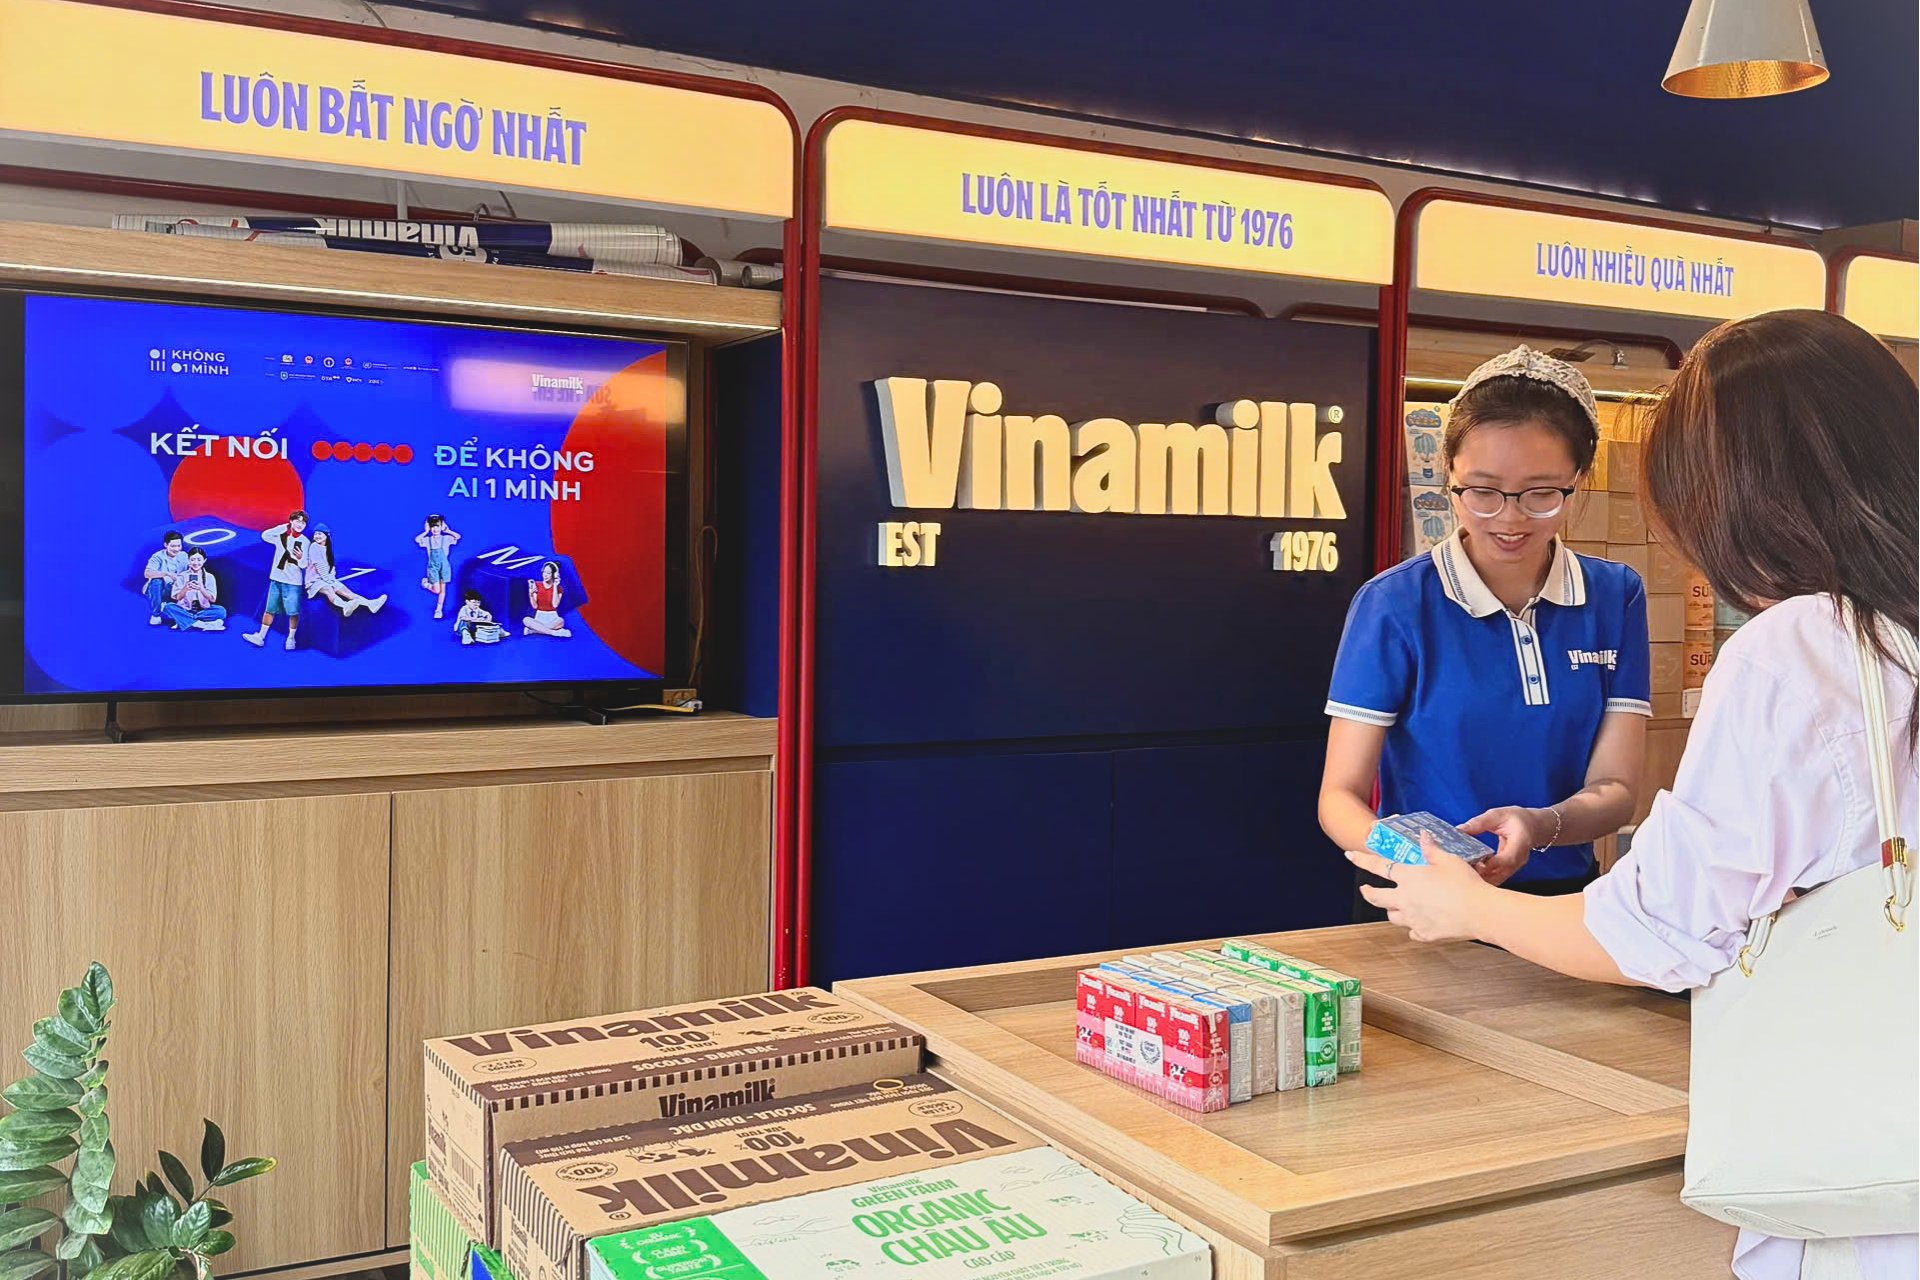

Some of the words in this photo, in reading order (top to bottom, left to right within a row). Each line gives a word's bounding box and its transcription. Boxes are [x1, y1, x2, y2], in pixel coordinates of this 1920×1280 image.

[201, 72, 308, 131] LUÔN
[319, 79, 394, 141] BẤT
[403, 97, 483, 152] NGỜ
[491, 106, 588, 166] NHẤT
[962, 172, 1033, 220] LUÔN
[1040, 179, 1072, 224] LÀ
[1078, 181, 1127, 230] TỐT
[1132, 190, 1197, 238] NHẤT
[1202, 200, 1236, 243] TỪ
[1241, 208, 1293, 249] 1976
[1536, 241, 1587, 280] LUÔN
[1592, 245, 1645, 287] NHIỀU
[1690, 257, 1734, 297] NHẤT
[172, 349, 225, 363] KHÔNG
[192, 362, 229, 375] MÌNH
[531, 373, 583, 390] Vinamilk
[151, 424, 219, 457] KẾT
[228, 426, 288, 459] NỐI
[434, 436, 478, 468] ĐỂ
[486, 443, 594, 473] KHÔNG
[884, 376, 1347, 519] Vinamilk
[449, 477, 478, 498] AI
[486, 478, 496, 498] 1
[505, 474, 582, 501] MÌNH
[881, 520, 941, 567] EST
[1274, 530, 1338, 572] 1976
[1567, 650, 1617, 665] Vinailk
[445, 993, 840, 1057] Vinamilk
[632, 1057, 697, 1072] SOCOLA
[659, 1079, 775, 1118] Vinamilk
[754, 1103, 816, 1120] SOCOLA
[575, 1119, 1019, 1217] Vinamilk
[868, 1177, 920, 1193] Vinamilk
[851, 1189, 908, 1208] GREEN
[908, 1179, 959, 1196] FARM
[851, 1188, 1012, 1238] ORGANIC
[880, 1225, 990, 1266] CHÂU
[979, 1213, 1047, 1244] ÂU
